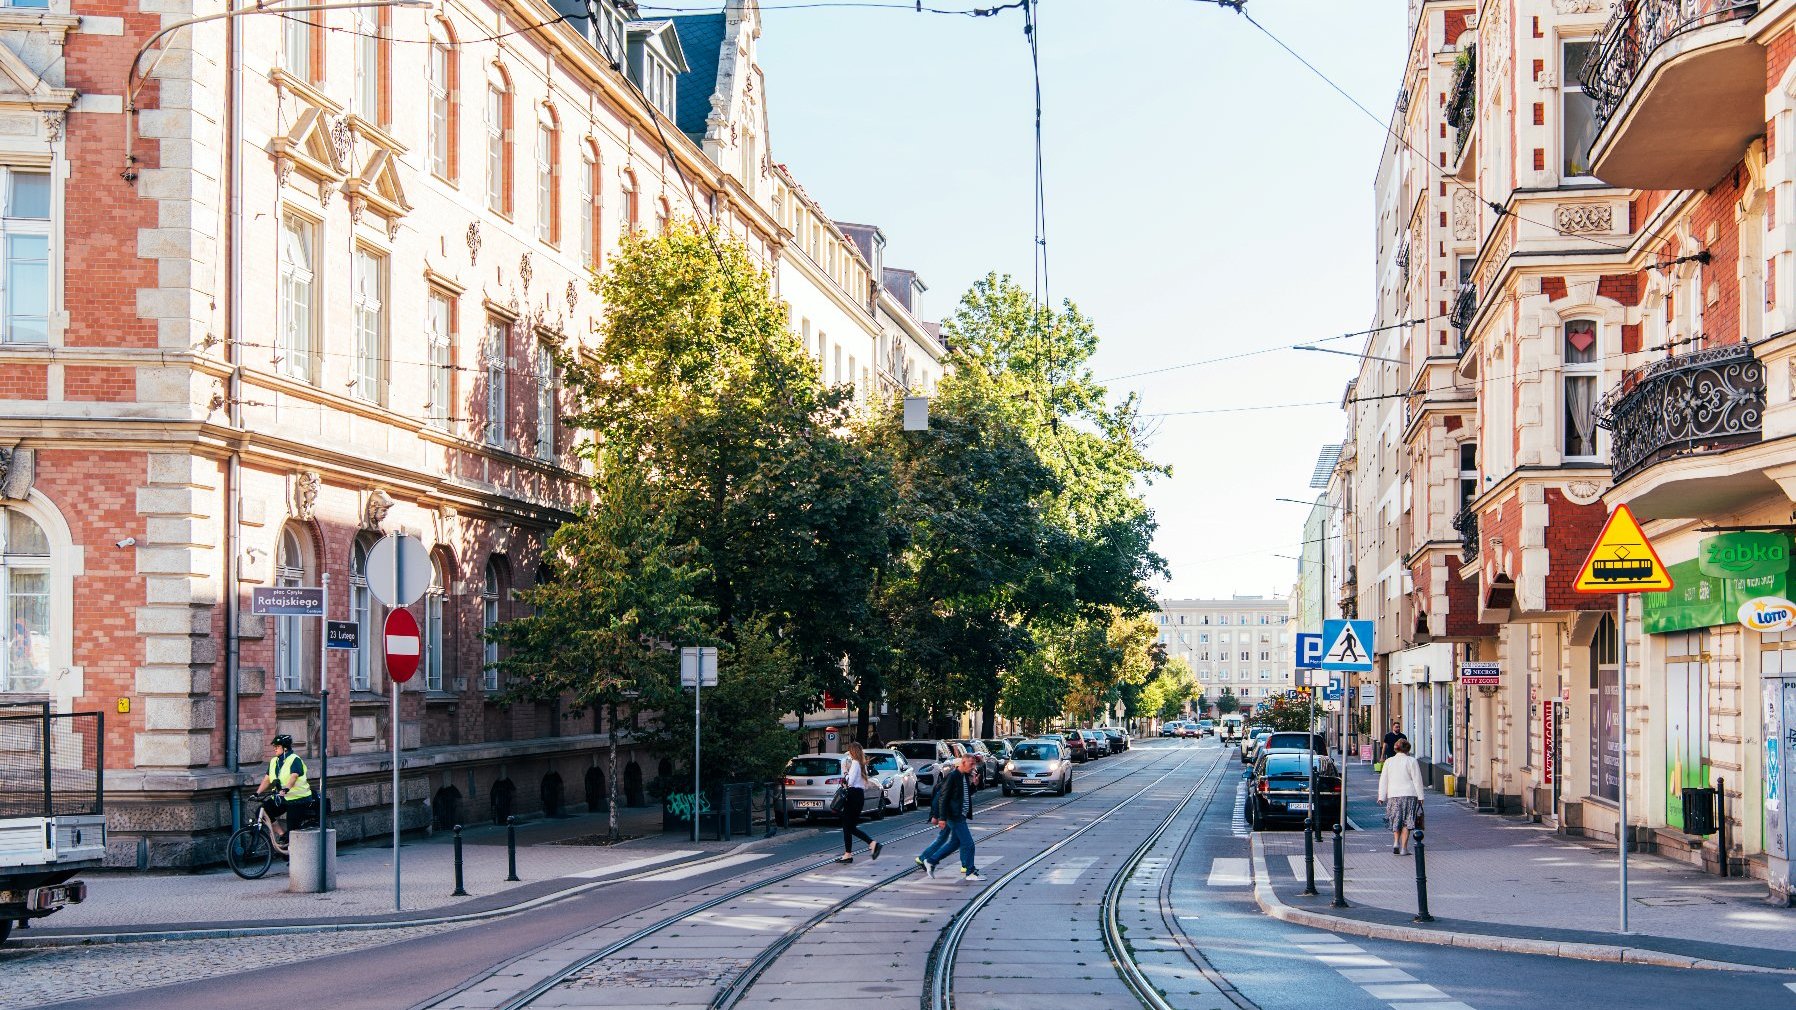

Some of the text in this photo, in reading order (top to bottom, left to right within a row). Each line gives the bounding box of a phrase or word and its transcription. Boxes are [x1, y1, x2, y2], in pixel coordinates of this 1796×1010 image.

[1708, 542, 1783, 563] żabka
[258, 596, 318, 608] Ratajskiego
[1757, 610, 1786, 623] LOTTO
[339, 630, 355, 641] Lutego
[1327, 680, 1337, 694] P
